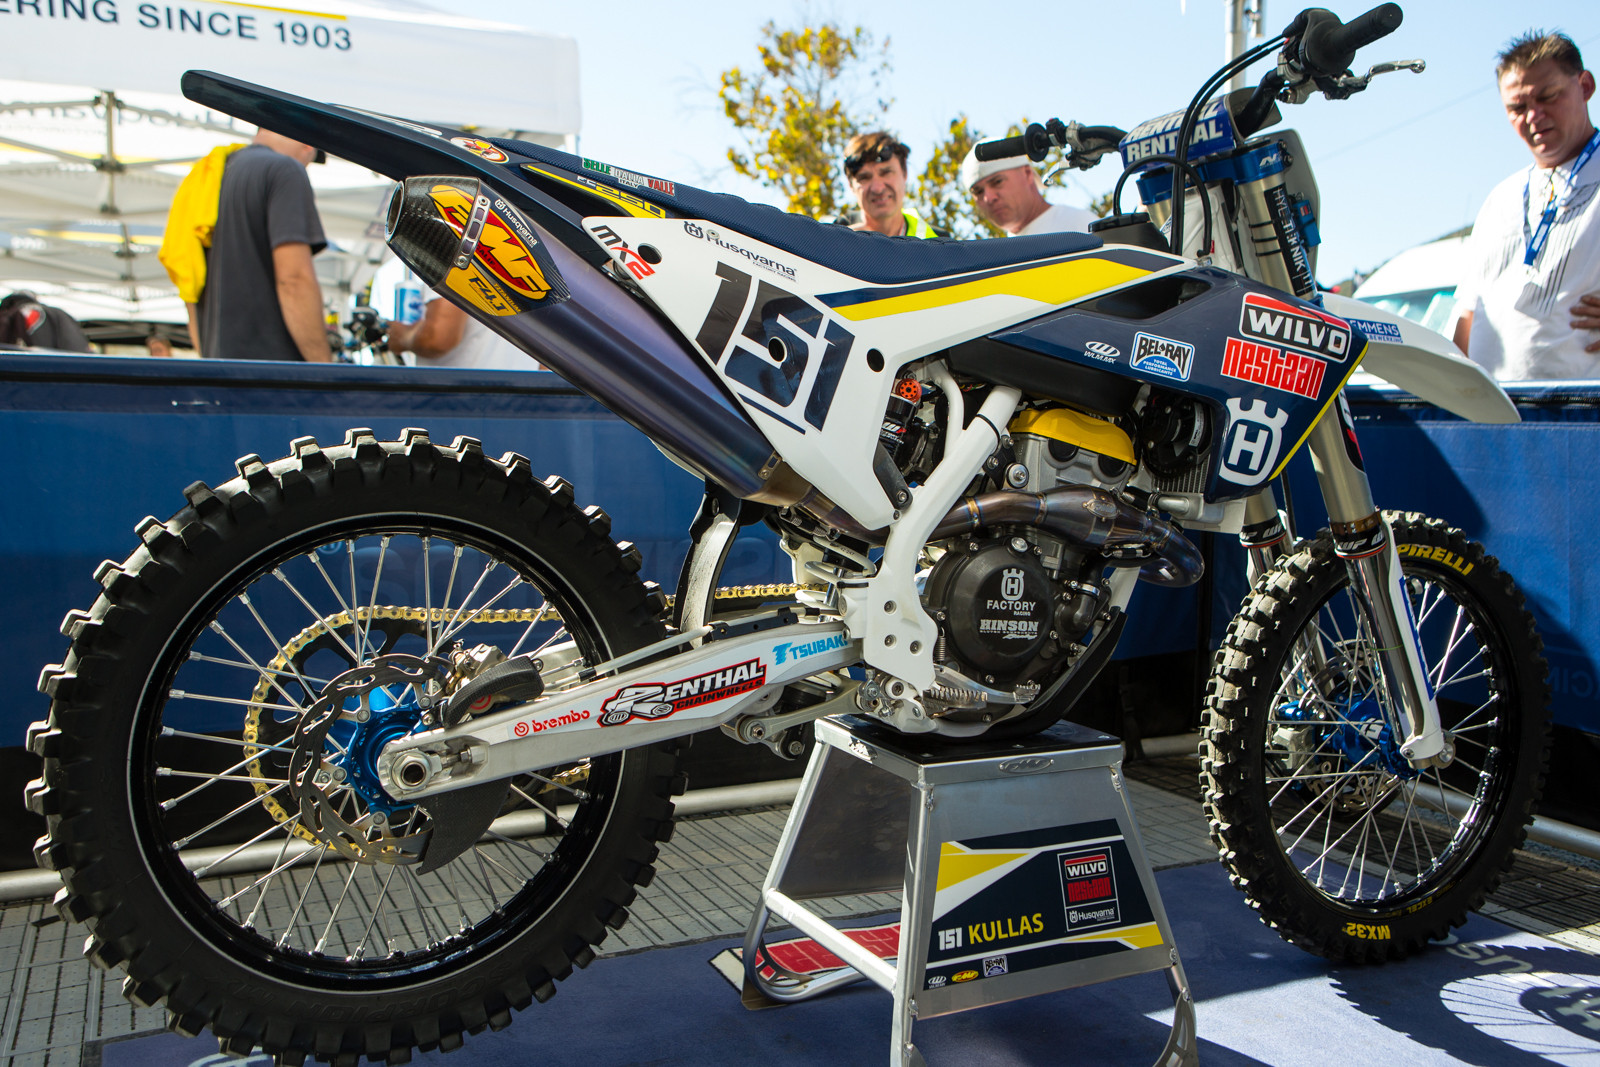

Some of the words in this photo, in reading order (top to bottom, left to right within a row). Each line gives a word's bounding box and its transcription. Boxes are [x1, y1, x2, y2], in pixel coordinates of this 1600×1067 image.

[0, 0, 118, 24] RING
[138, 3, 258, 39] SINCE
[274, 21, 351, 50] 1903
[1127, 118, 1224, 163] RENTAL
[583, 157, 611, 175] SELLE
[647, 178, 675, 196] VALLE
[619, 179, 639, 189] ITALY
[502, 207, 539, 245] Husqvarna
[591, 225, 656, 281] MX2
[706, 232, 798, 277] Husqvarna
[694, 261, 856, 432] 151
[1248, 308, 1348, 355] WILVO
[1142, 360, 1177, 373] PERFORMANCE
[1144, 365, 1173, 376] LUBRICANTS
[1220, 336, 1328, 400] nestaan
[1396, 543, 1475, 576] PIRELLI
[986, 599, 1036, 611] FACTORY
[980, 619, 1039, 631] HINSON
[675, 678, 763, 710] CHAINWHEELS
[532, 710, 591, 733] brembo
[1067, 861, 1107, 877] WILVO
[1078, 908, 1115, 920] Husqvarna
[938, 927, 962, 951] 151
[968, 912, 1044, 945] KULLAS
[1346, 922, 1391, 940] MX32
